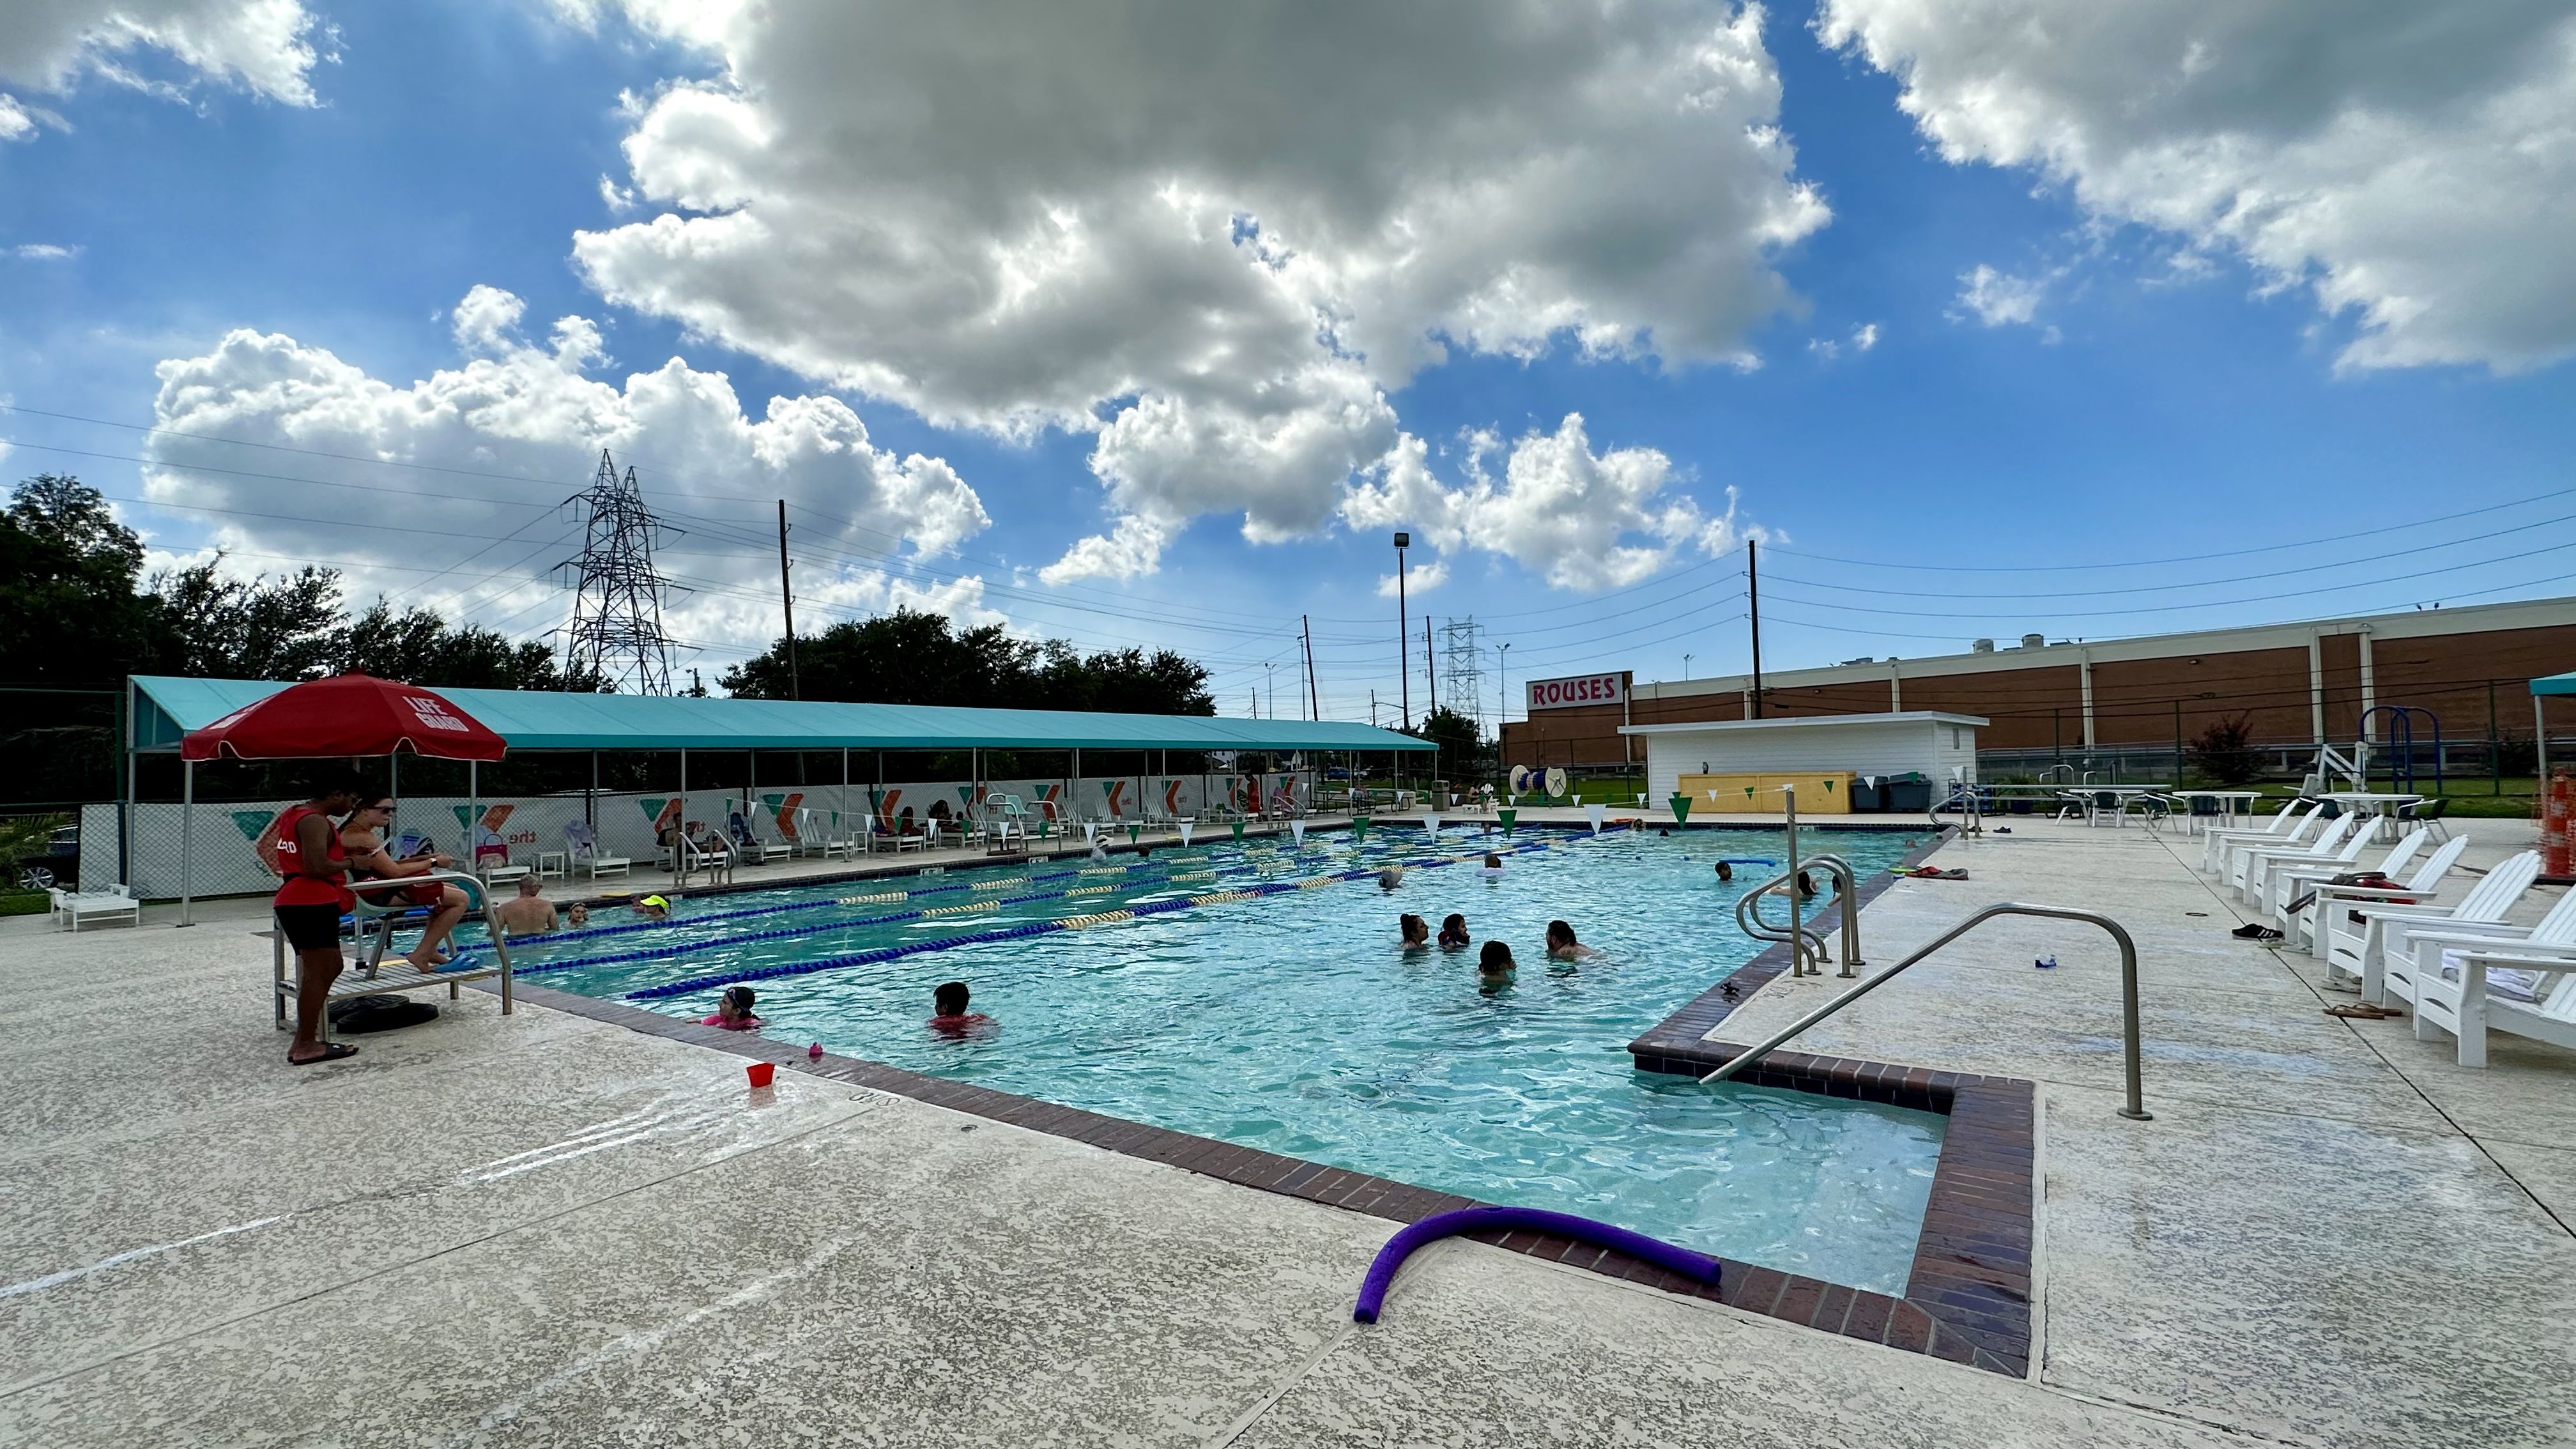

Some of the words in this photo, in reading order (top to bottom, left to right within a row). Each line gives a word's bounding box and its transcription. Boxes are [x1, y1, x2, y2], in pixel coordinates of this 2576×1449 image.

[1533, 678, 1614, 705] ROUSES
[402, 696, 448, 715] LIFE
[415, 712, 470, 732] GUARD
